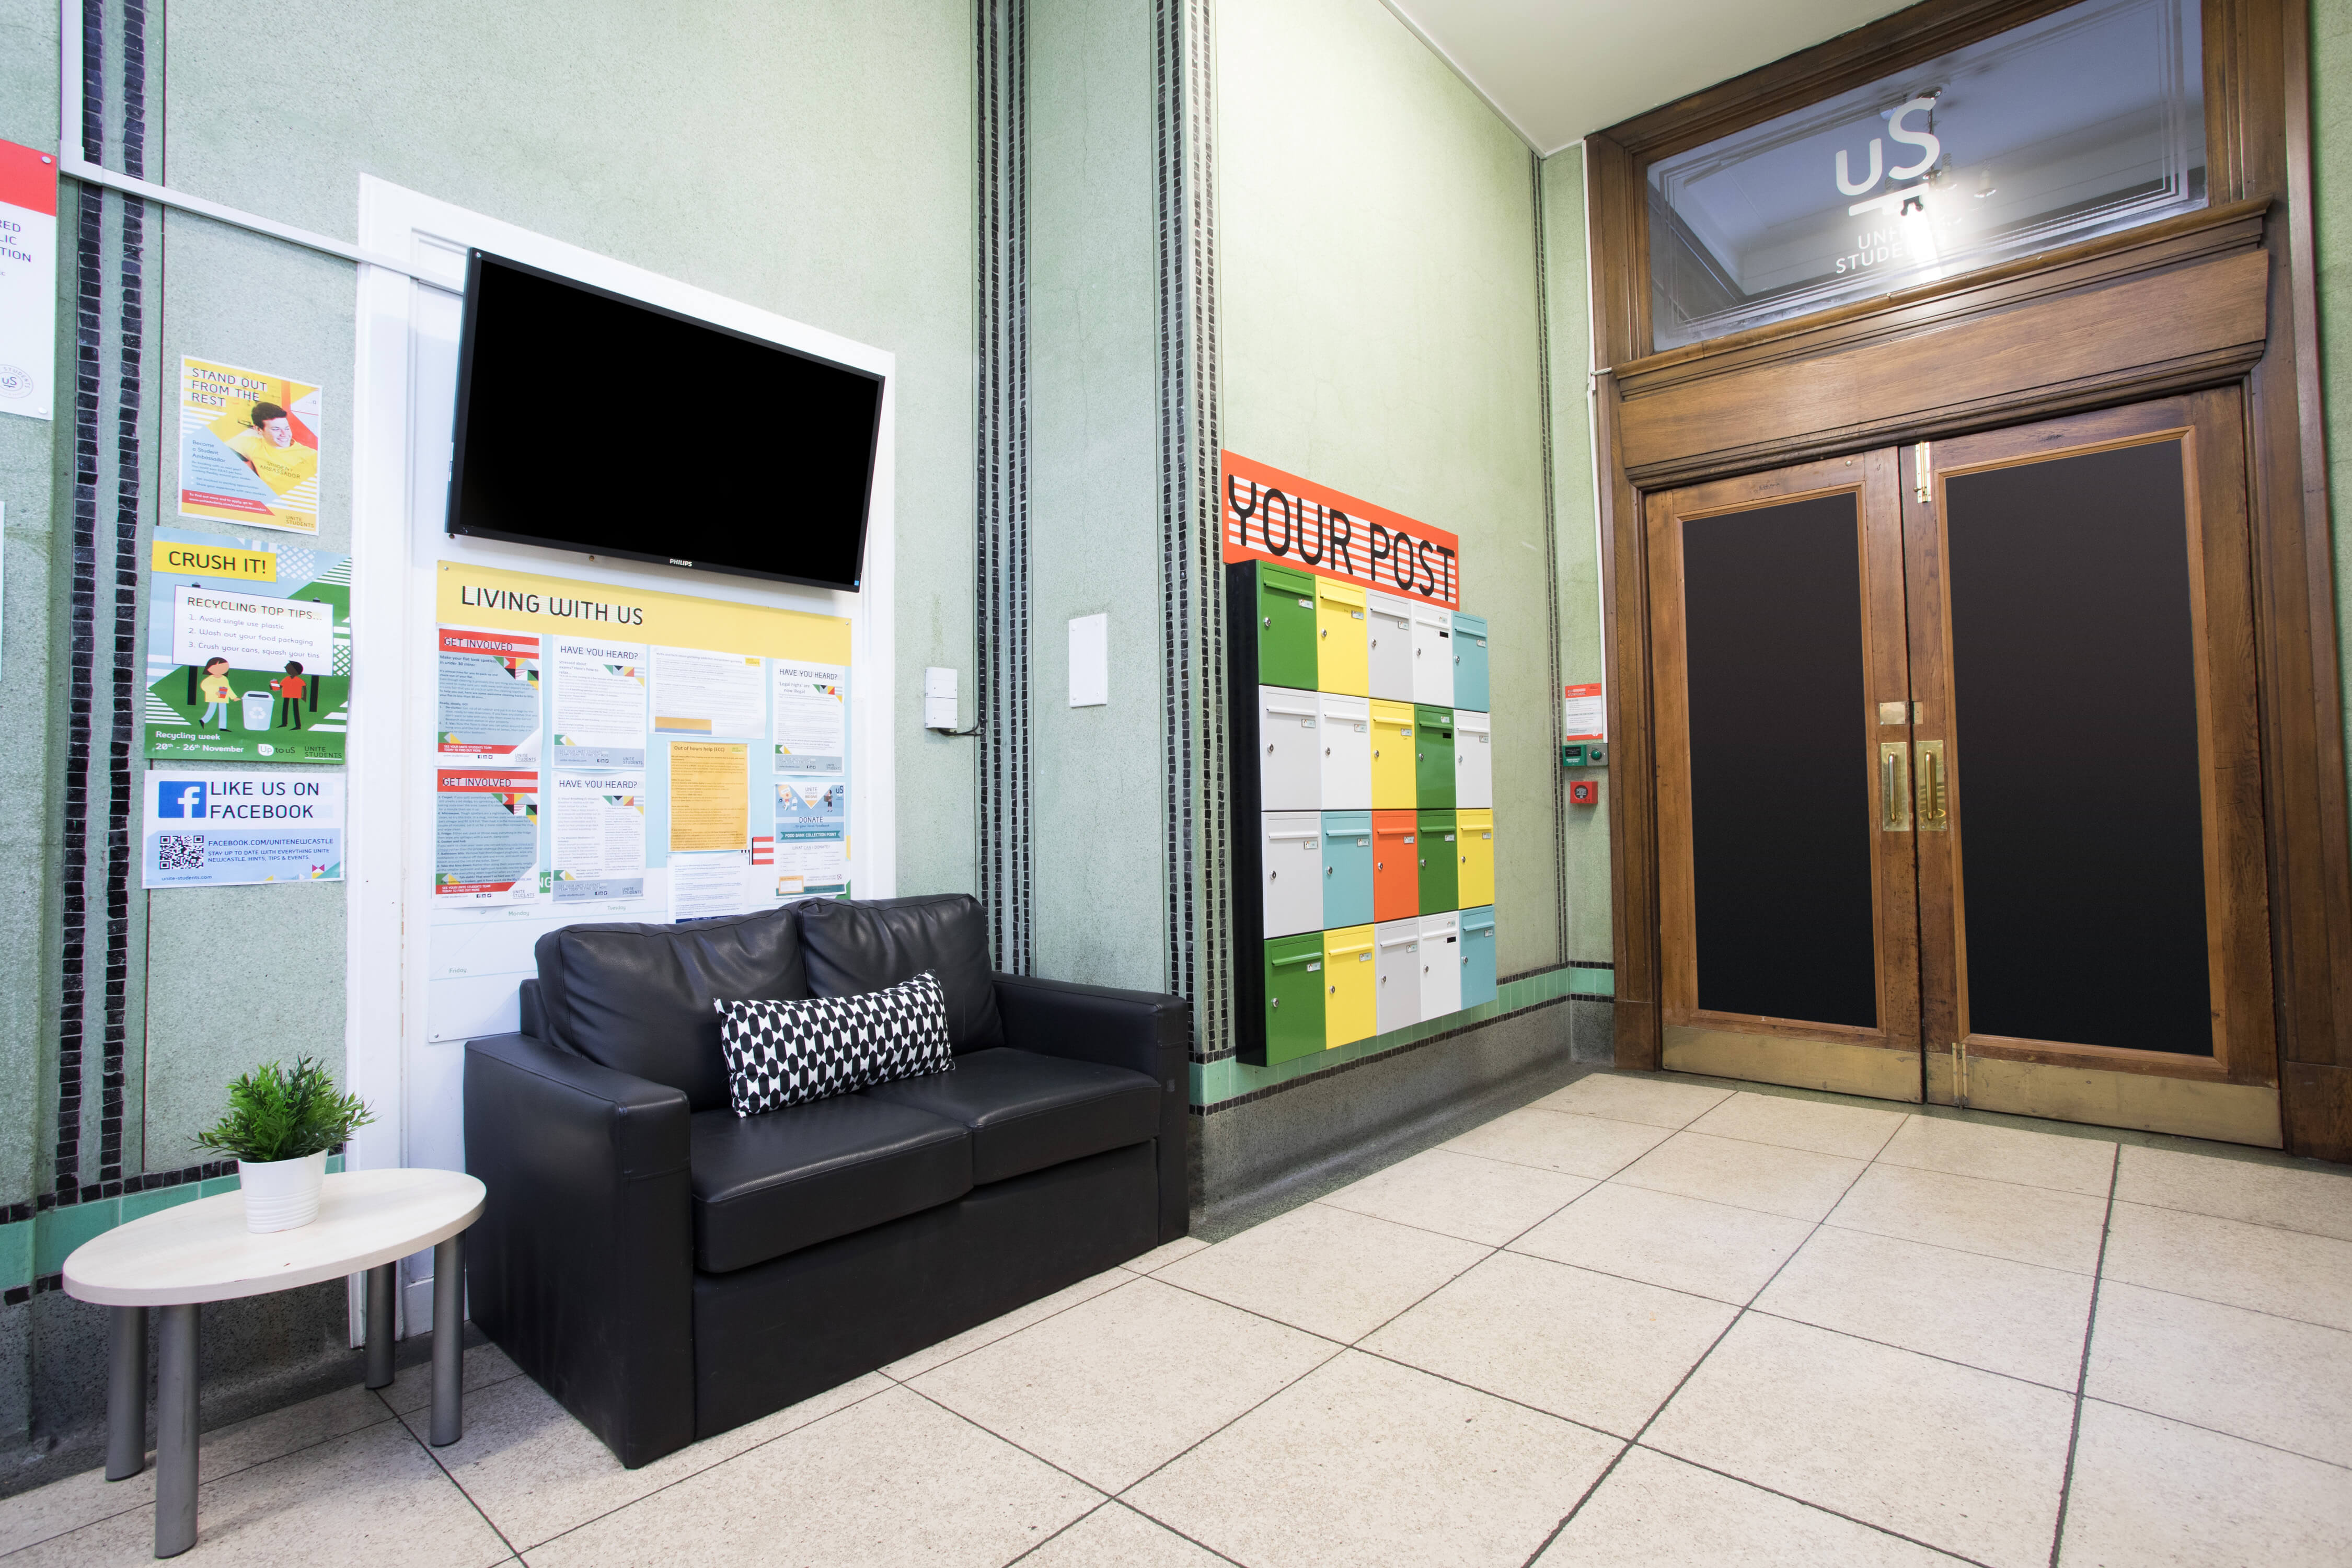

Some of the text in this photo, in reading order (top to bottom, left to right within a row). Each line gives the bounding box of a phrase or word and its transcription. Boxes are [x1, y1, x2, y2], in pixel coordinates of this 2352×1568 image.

[1836, 98, 1940, 195] uS
[0, 220, 21, 232] ED
[192, 368, 267, 391] STAND OUT
[192, 380, 259, 402] FROM THE
[192, 393, 225, 406] REST
[192, 454, 225, 463] Ambassador
[260, 465, 301, 479] AMBASSADOR
[267, 462, 293, 471] STUDENT
[1228, 474, 1455, 601] YOUR POST
[169, 551, 266, 573] CRUSH IT!
[670, 558, 693, 567] PHILIPS
[188, 597, 322, 621] RECYCLING TOP TIPS...
[462, 585, 643, 625] LIVING WITH US
[199, 615, 221, 624] Avoid
[224, 618, 244, 627] single
[278, 638, 313, 646] packaging
[444, 637, 513, 651] GET INVOLVED
[560, 645, 638, 660] HAVE YOU HEARD?
[156, 731, 195, 741] Recycling
[261, 745, 272, 754] Up
[211, 781, 253, 795] LIKE
[262, 782, 286, 795] US
[294, 782, 319, 795] ON
[443, 778, 511, 787] GET INVOLVED
[210, 805, 314, 818] FACEBOOK
